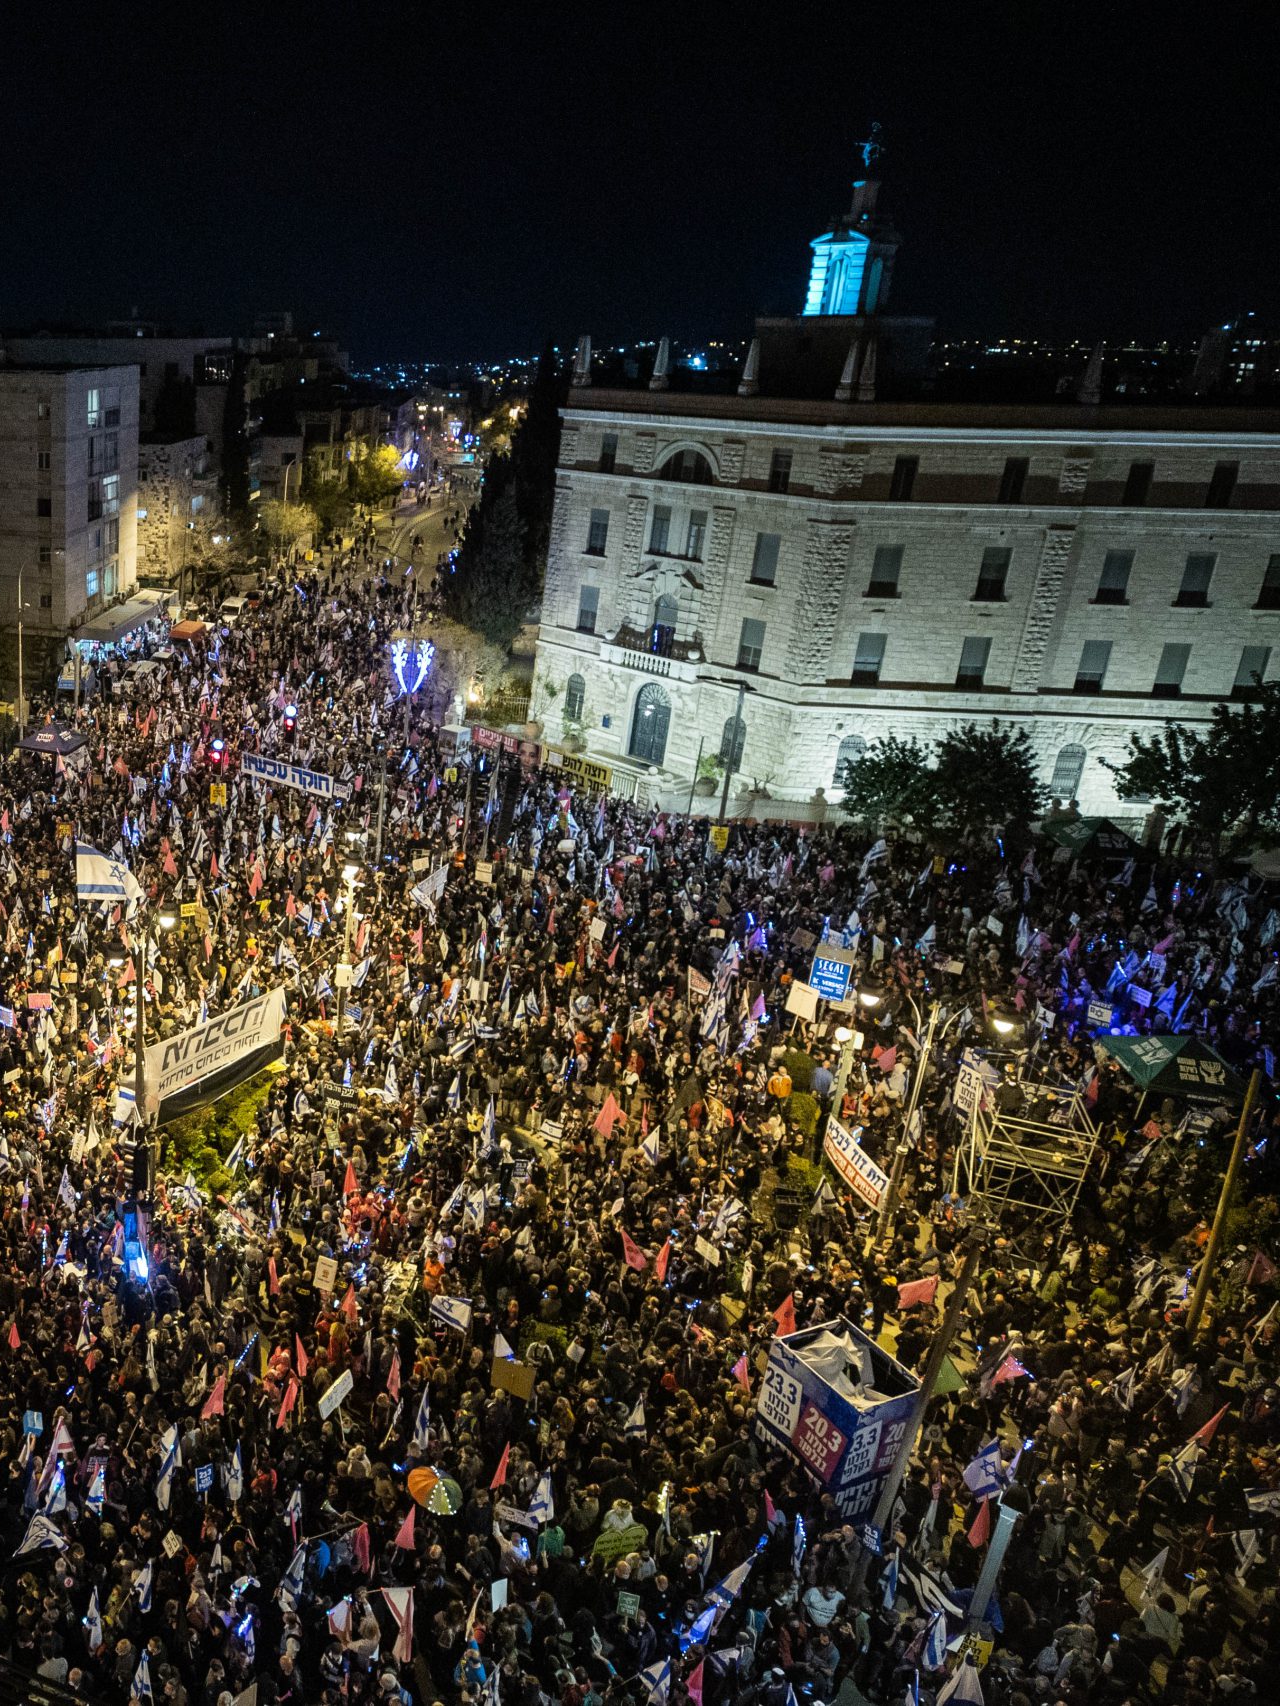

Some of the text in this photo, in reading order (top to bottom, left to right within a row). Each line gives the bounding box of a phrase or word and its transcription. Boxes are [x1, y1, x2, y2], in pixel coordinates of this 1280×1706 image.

[243, 756, 330, 793] חוקה עכשיו!
[584, 763, 607, 780] רוצה
[818, 960, 844, 974] SEGAL
[765, 1366, 798, 1405] 23.3
[764, 1401, 791, 1431] בקלפי
[768, 1391, 790, 1415] כולנו
[805, 1407, 842, 1452] 20.3
[850, 1428, 877, 1453] 3.3
[799, 1436, 826, 1473] בבלפור
[806, 1430, 828, 1457] כולנו
[843, 1459, 870, 1477] בקלפי
[848, 1449, 868, 1466] כולנו
